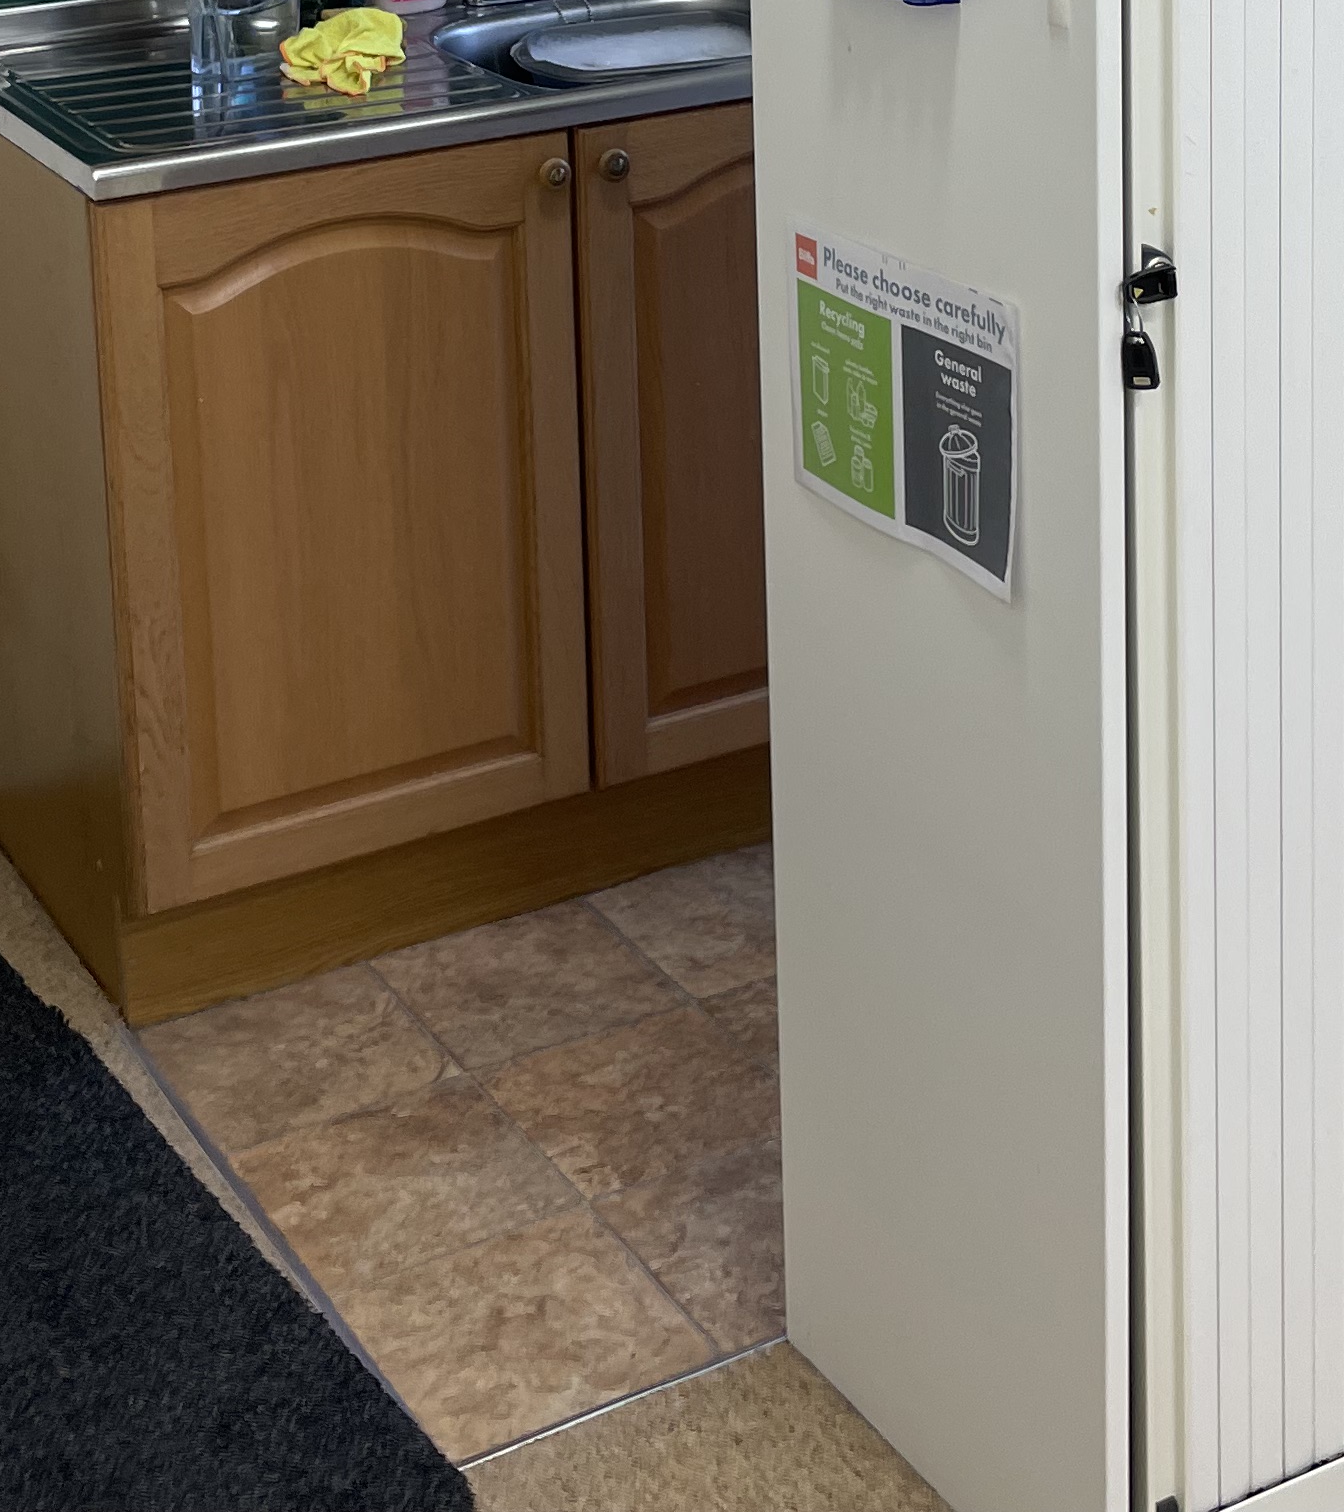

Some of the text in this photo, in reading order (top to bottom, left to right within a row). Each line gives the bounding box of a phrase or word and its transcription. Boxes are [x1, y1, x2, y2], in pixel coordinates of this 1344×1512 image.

[823, 245, 869, 285] Please
[872, 268, 931, 308] choose
[935, 297, 1006, 346] carefully
[835, 277, 993, 353] Put the right waste in the right bin
[819, 299, 865, 339] Recycling
[934, 349, 982, 383] General
[940, 372, 977, 398] waste
